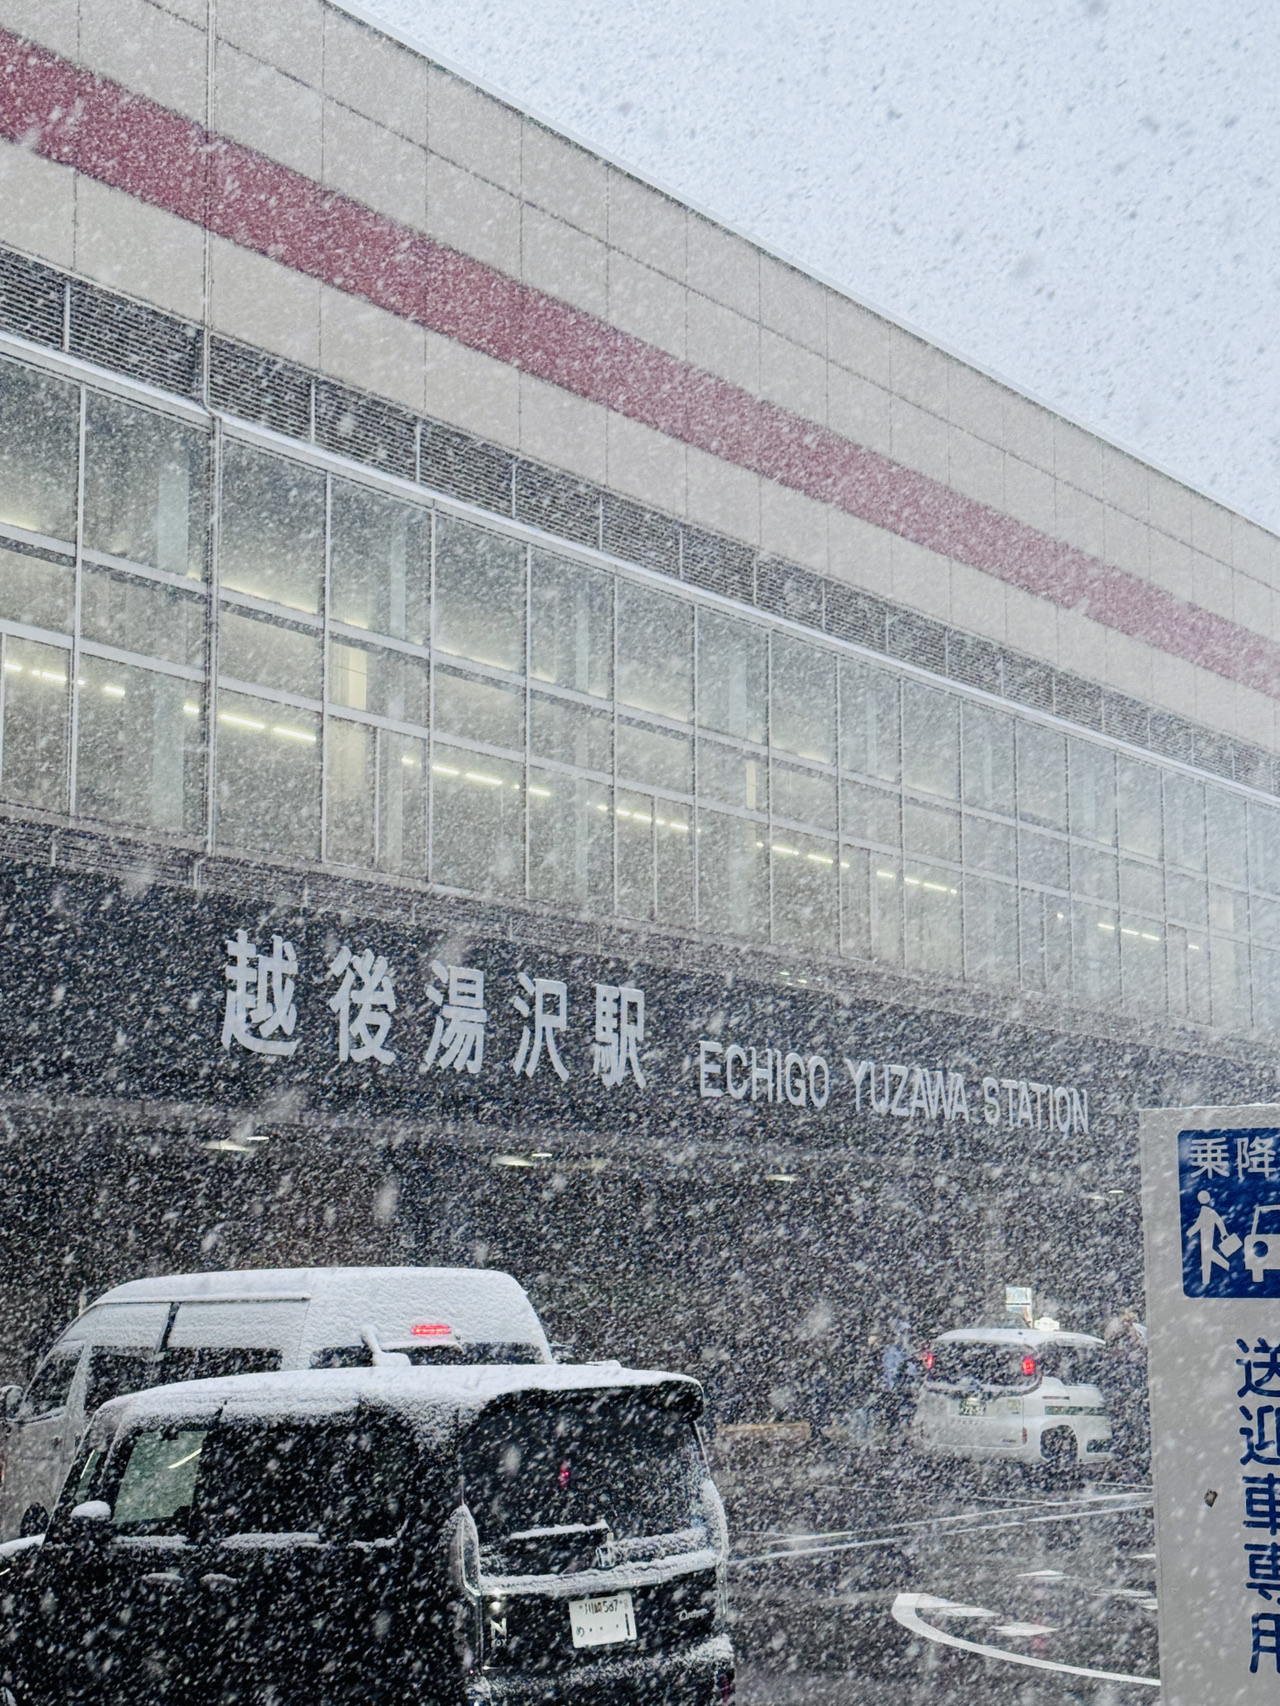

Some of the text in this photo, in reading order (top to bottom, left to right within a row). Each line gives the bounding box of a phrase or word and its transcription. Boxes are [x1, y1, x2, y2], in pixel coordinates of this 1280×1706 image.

[221, 929, 647, 1089] 越後湯沢駅
[699, 1041, 1090, 1134] ECHIGO YUZAWA STATION
[1189, 1136, 1277, 1181] 乗降
